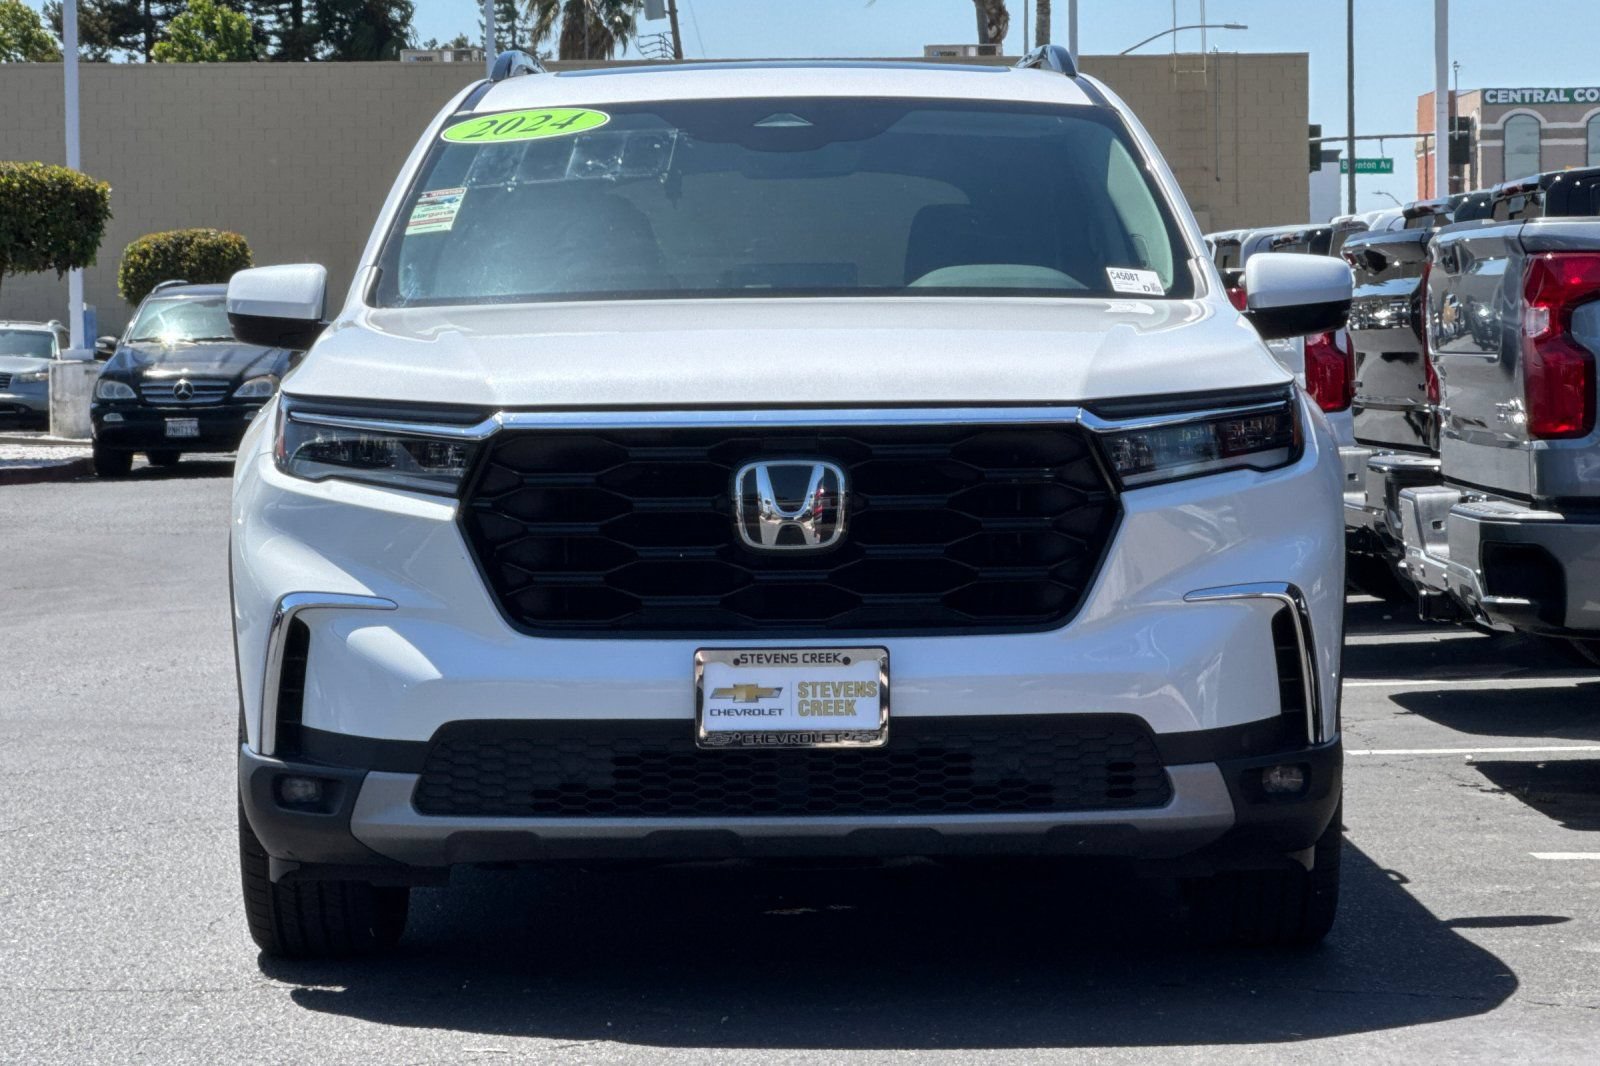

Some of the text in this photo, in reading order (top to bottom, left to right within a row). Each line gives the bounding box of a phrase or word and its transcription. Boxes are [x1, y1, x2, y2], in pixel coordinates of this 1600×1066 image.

[1485, 89, 1570, 104] CENTRAL
[463, 111, 587, 139] 2024
[1380, 160, 1391, 169] Av
[740, 652, 841, 664] STEVENS CREEK
[797, 681, 878, 699] STEVENS
[709, 708, 784, 717] CHEVROLET
[797, 699, 857, 717] CREEK
[742, 732, 842, 745] CHEVROLET
